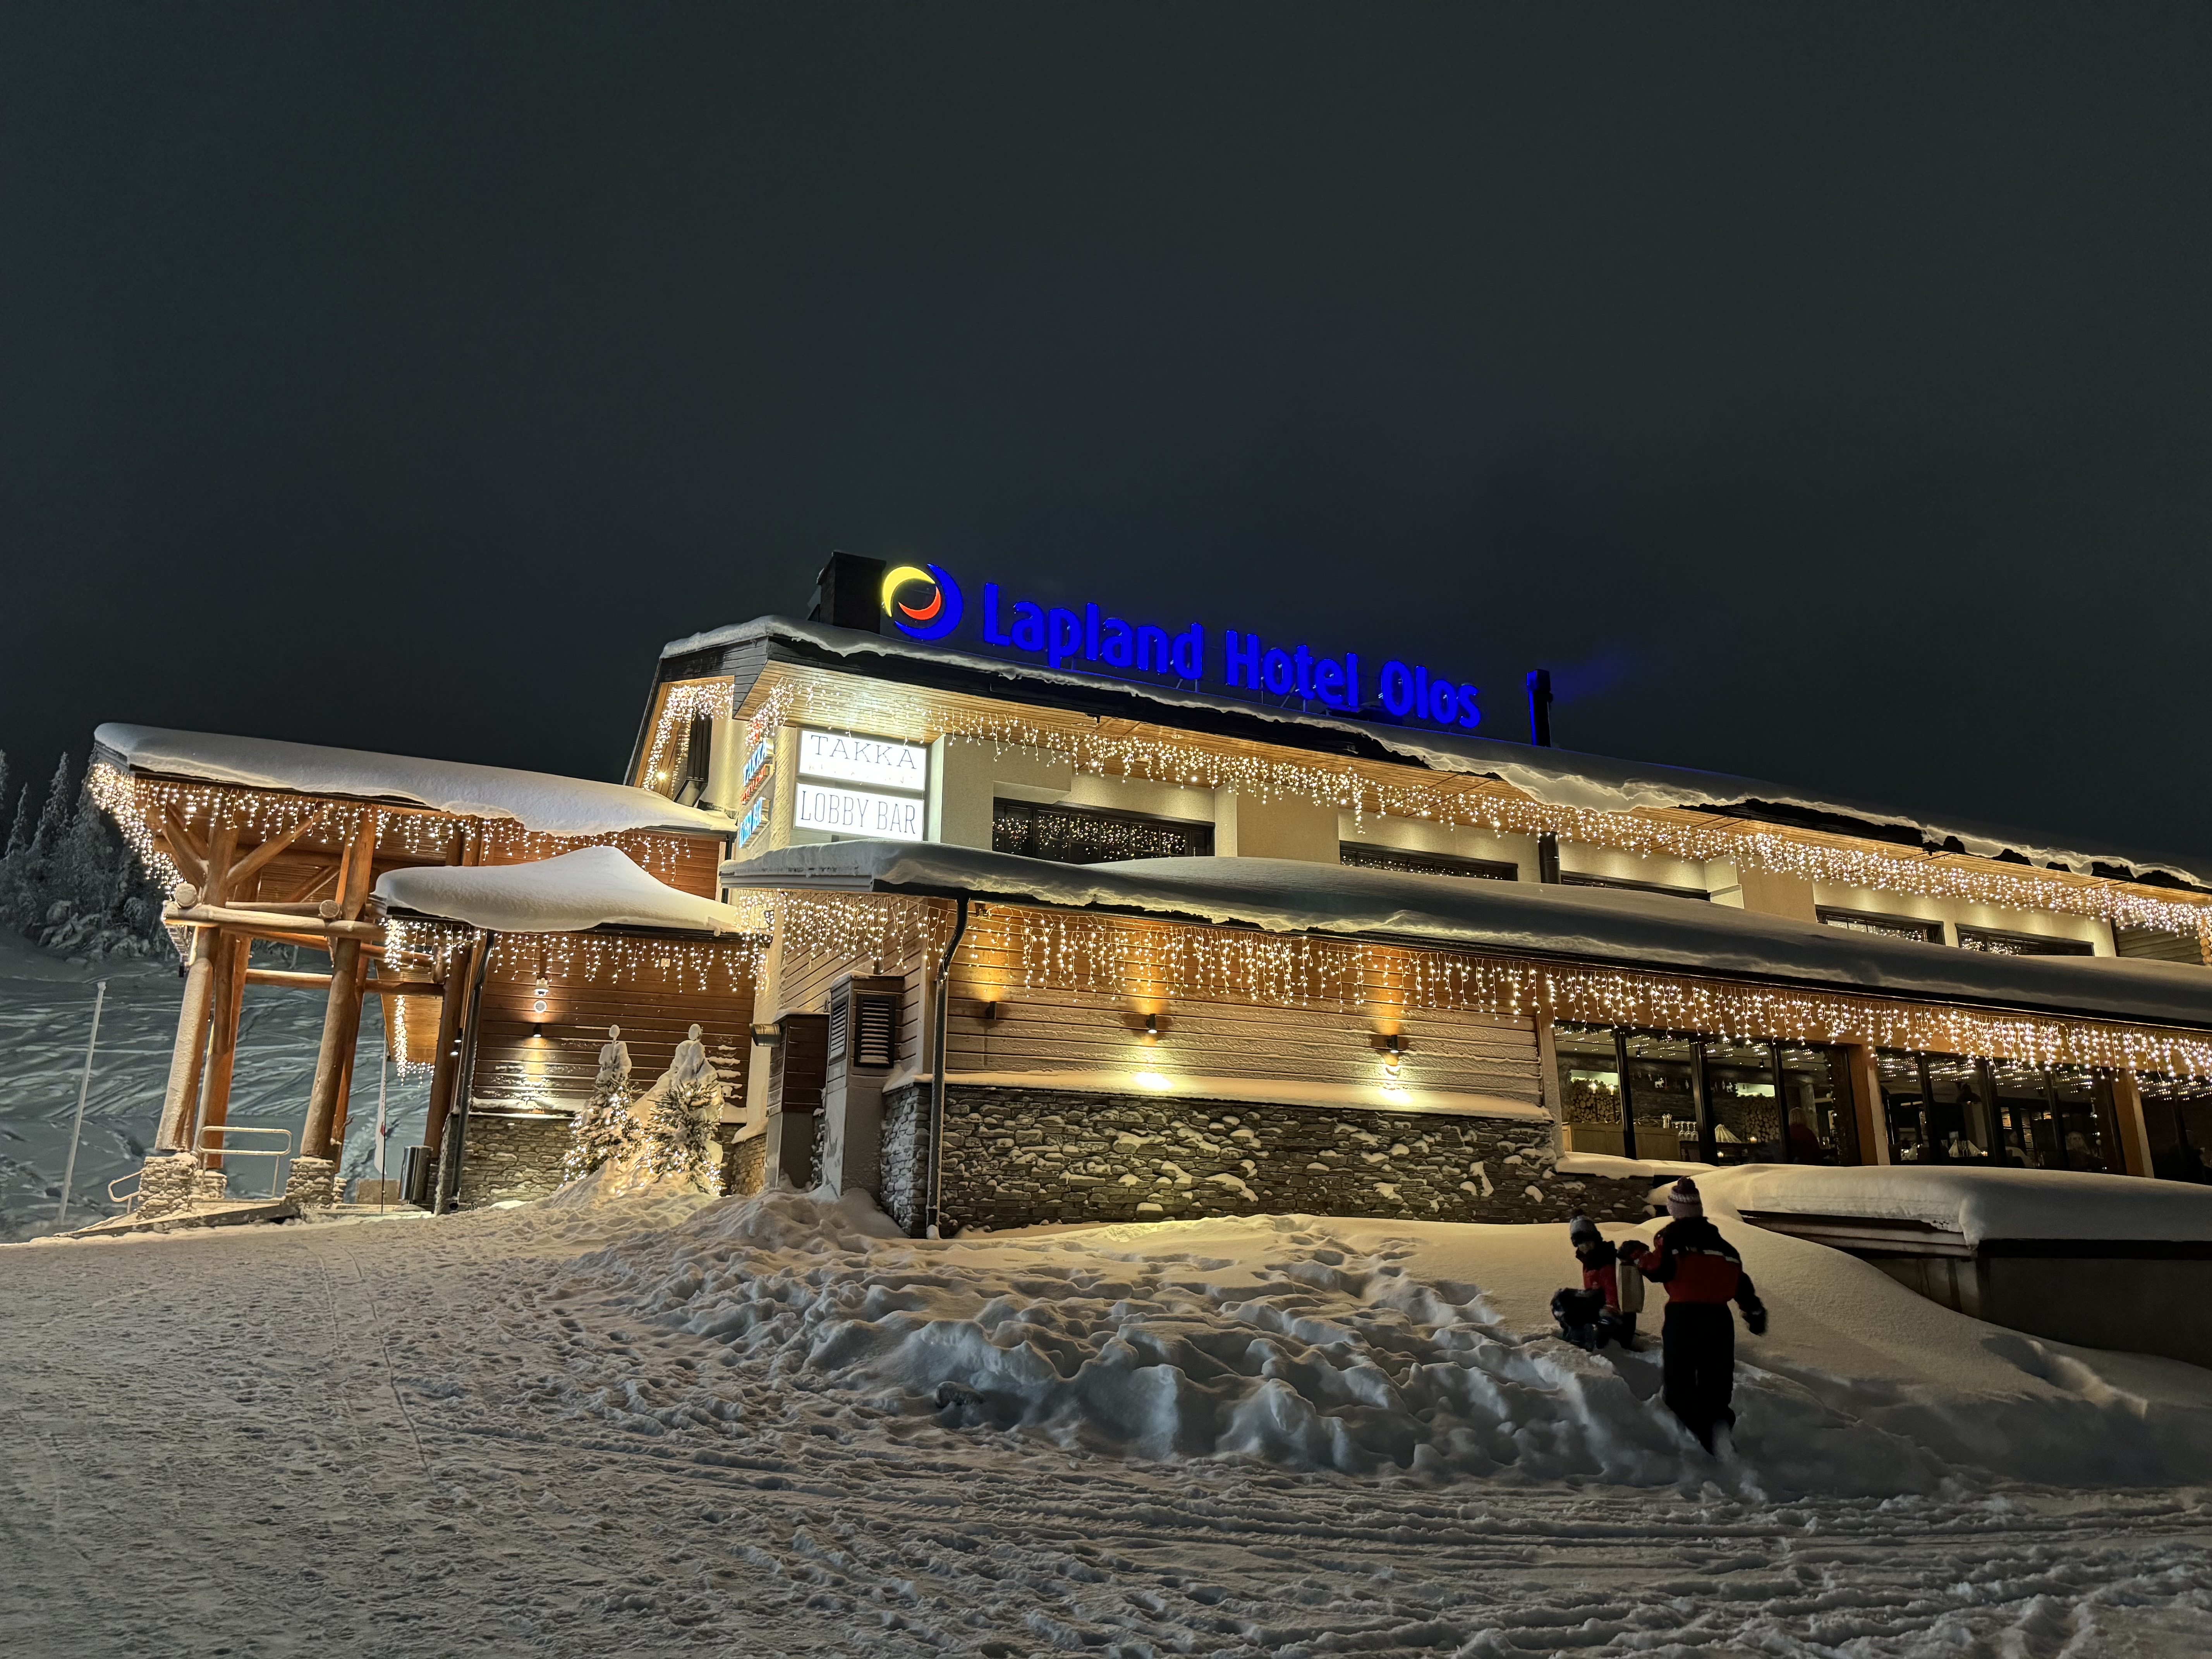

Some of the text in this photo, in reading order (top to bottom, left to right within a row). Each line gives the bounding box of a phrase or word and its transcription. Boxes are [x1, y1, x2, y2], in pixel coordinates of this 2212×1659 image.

[983, 581, 1481, 729] Lapland Hotel Olos
[811, 735, 917, 769] TAKKA
[801, 791, 916, 834] LOBBY BAR
